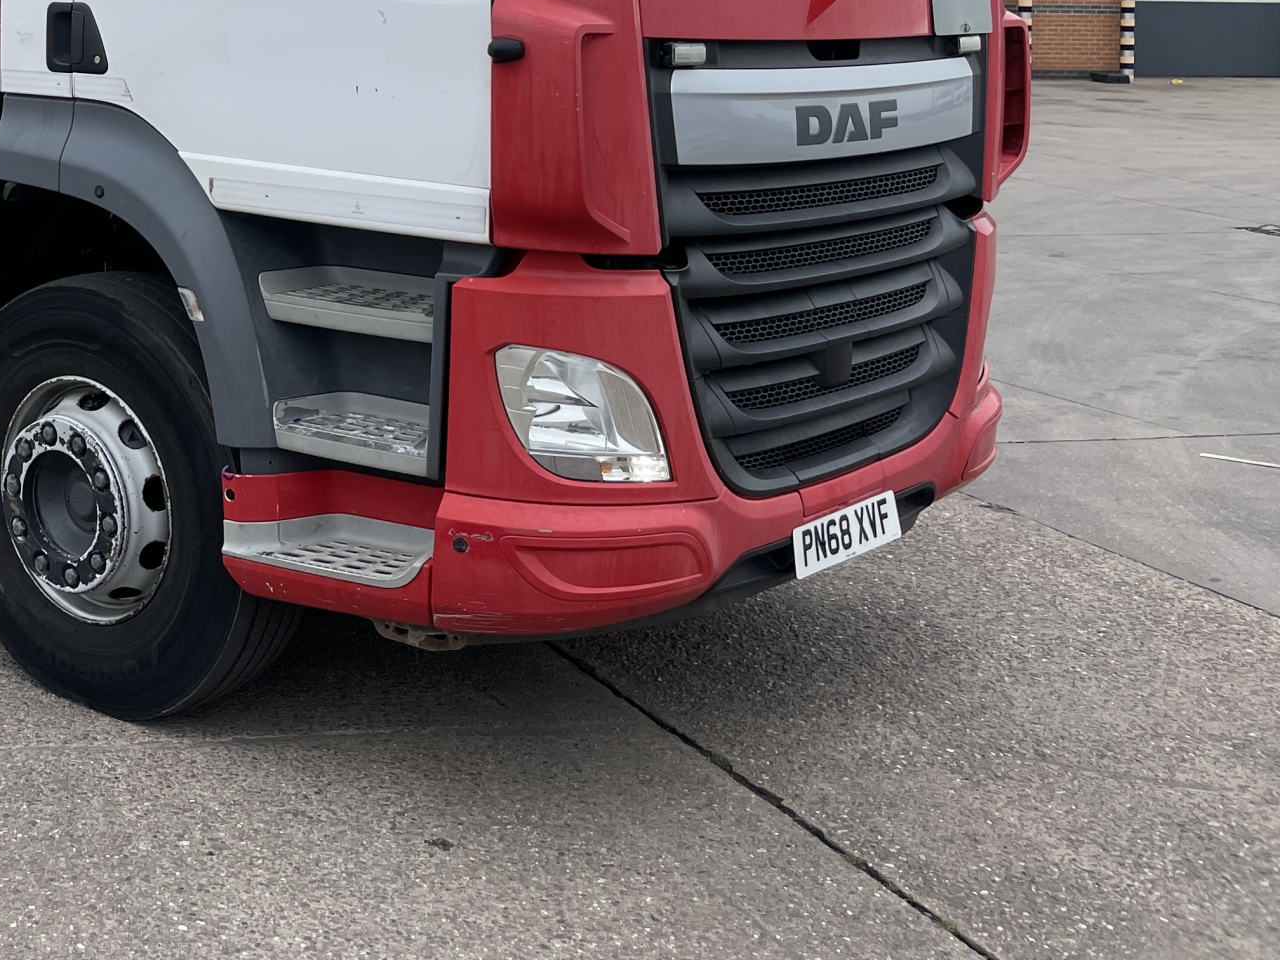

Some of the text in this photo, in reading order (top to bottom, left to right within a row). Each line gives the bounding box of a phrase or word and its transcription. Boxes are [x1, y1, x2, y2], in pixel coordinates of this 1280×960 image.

[795, 99, 899, 147] DAF
[802, 497, 889, 568] PN68 XVF
